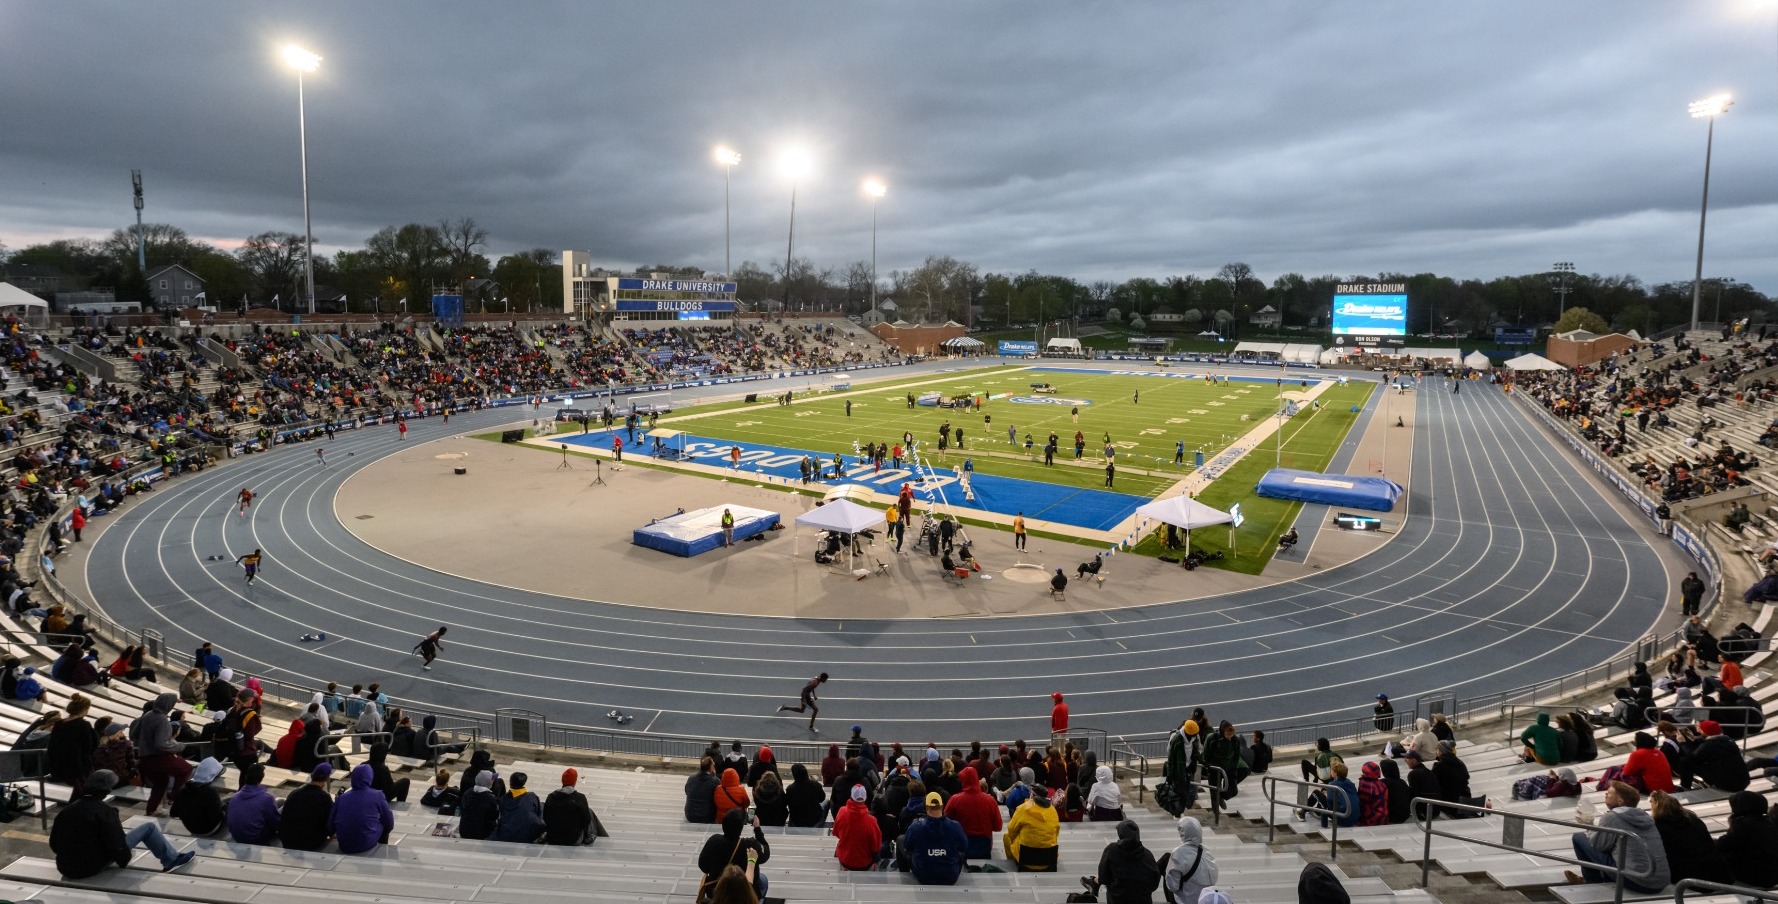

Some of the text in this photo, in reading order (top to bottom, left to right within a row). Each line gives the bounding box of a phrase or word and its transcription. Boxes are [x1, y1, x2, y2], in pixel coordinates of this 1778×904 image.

[642, 280, 725, 292] DRAKE UNIVERSITY
[1337, 284, 1405, 293] DRAKE STADIUM
[657, 301, 703, 311] BULLDOGS
[927, 849, 947, 857] USA
